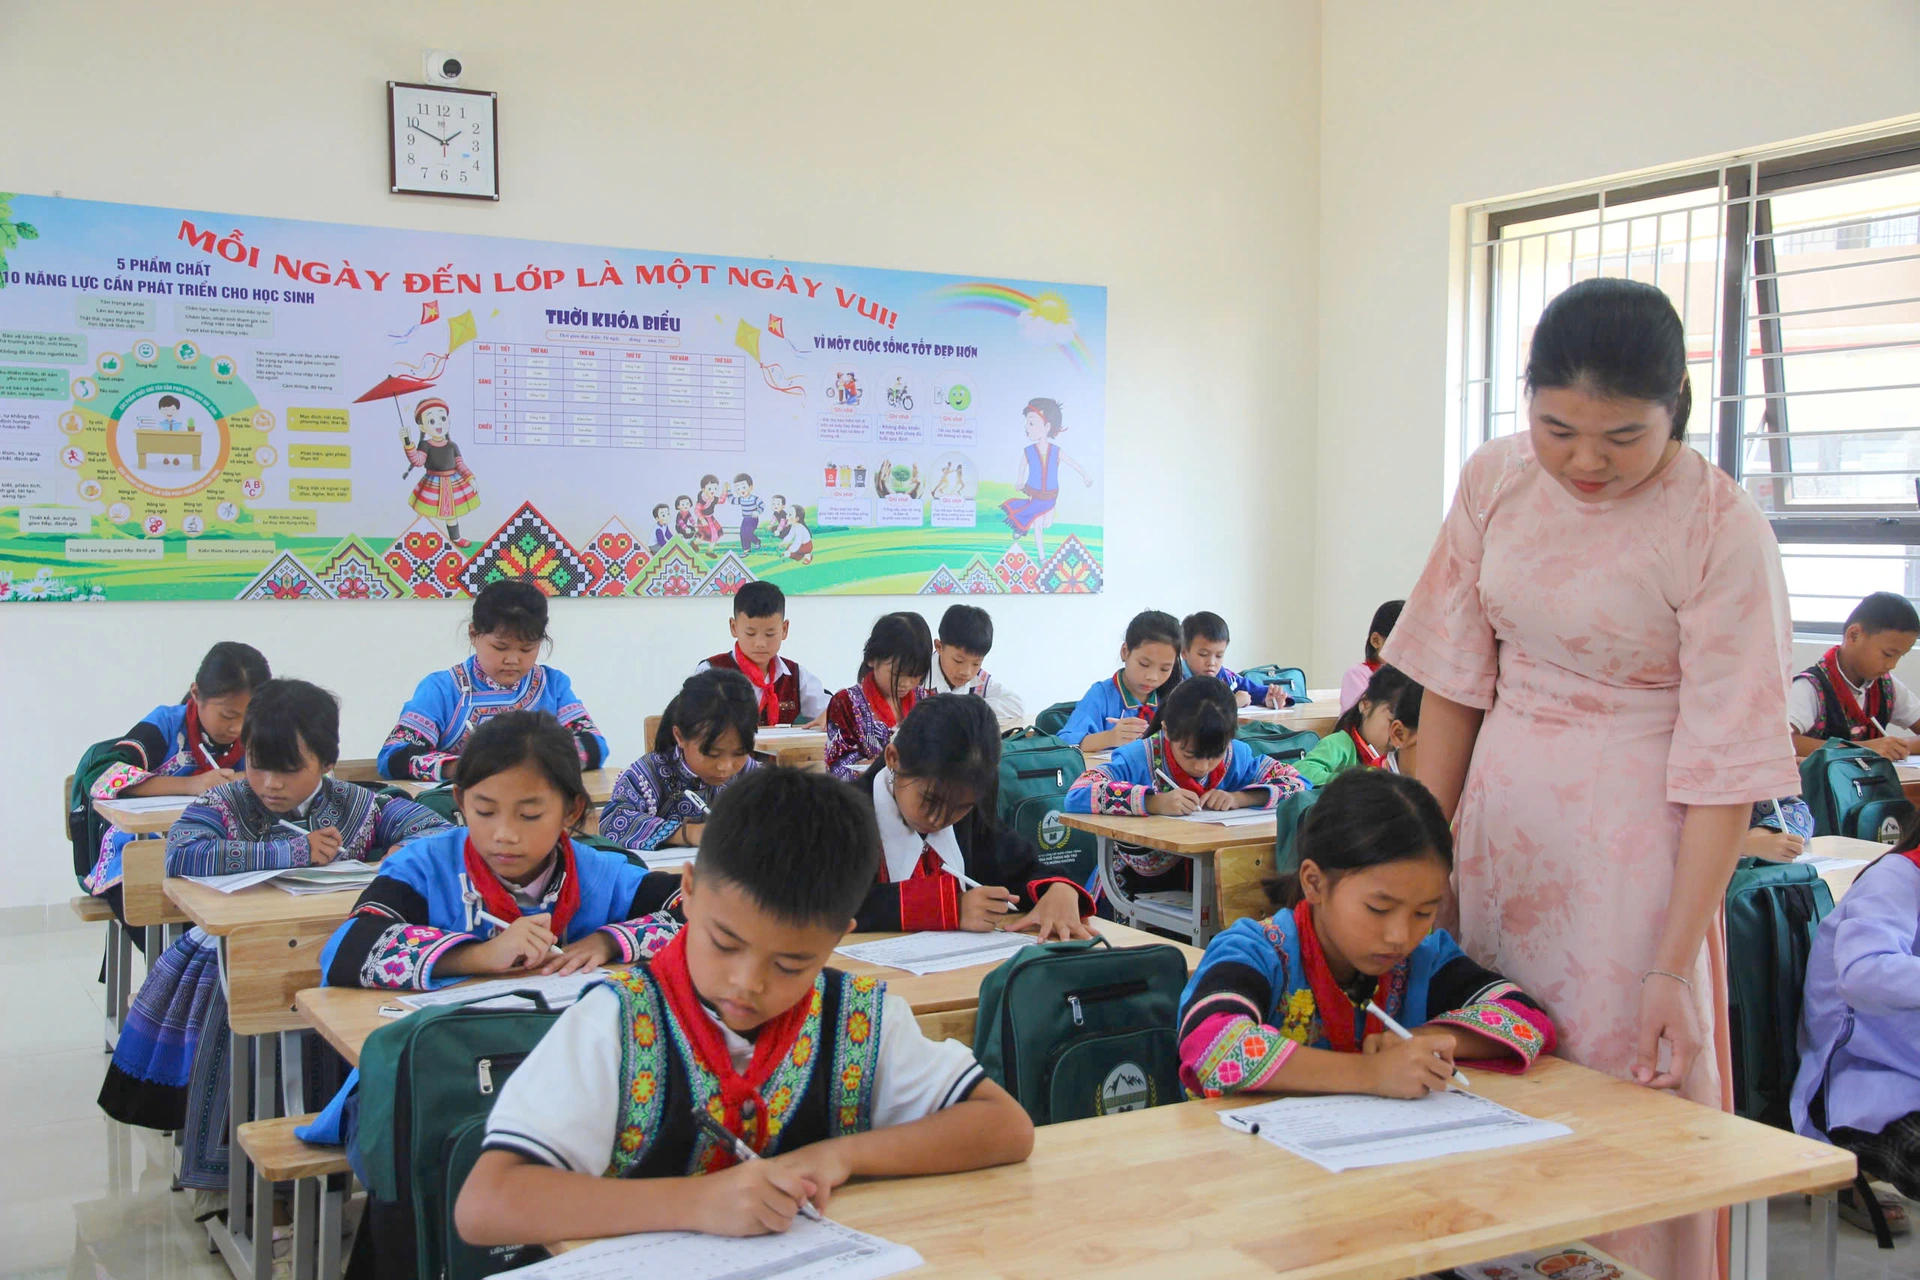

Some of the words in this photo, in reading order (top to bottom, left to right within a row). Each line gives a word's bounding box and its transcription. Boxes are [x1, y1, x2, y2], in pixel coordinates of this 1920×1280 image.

[417, 103, 430, 115] 11
[436, 105, 450, 117] 12
[460, 107, 466, 118] 1
[406, 116, 420, 128] 10
[472, 123, 480, 135] 2
[407, 134, 415, 145] 9
[472, 141, 480, 152] 3
[407, 153, 415, 165] 8
[473, 160, 480, 171] 4
[421, 167, 428, 179] 7
[440, 170, 449, 181] 6
[460, 171, 467, 182] 5
[117, 258, 126, 270] 5
[130, 255, 172, 274] PHẨM
[176, 259, 211, 277] CHẤT
[178, 219, 260, 268] MỖI
[273, 254, 391, 292] NGÀY
[403, 263, 481, 294] ĐẾN
[494, 264, 565, 293] LỚP
[577, 260, 623, 287] LÀ
[636, 258, 716, 290] MỘT
[727, 266, 823, 298] NGÀY
[835, 287, 899, 330] VUI!
[3, 271, 20, 284] 10
[25, 270, 67, 288] NĂNG
[71, 275, 99, 291] LỰC
[138, 278, 174, 295] PHÁT
[178, 279, 217, 298] TRIỂN
[221, 287, 249, 300] CHO
[252, 289, 280, 304] HỌC
[283, 291, 315, 304] SINH
[545, 307, 589, 326] THỜI
[592, 310, 639, 329] KHÓA
[643, 310, 681, 332] BIỂU
[814, 334, 825, 349] VÌ
[827, 335, 851, 353] MỘT
[853, 337, 881, 355] CUỘC
[883, 336, 910, 355] SỐNG
[911, 337, 932, 356] TỐT
[934, 343, 954, 360] ĐẸP
[956, 344, 978, 358] HƠN
[245, 481, 251, 489] A
[254, 481, 260, 489] B
[249, 488, 256, 497] C
